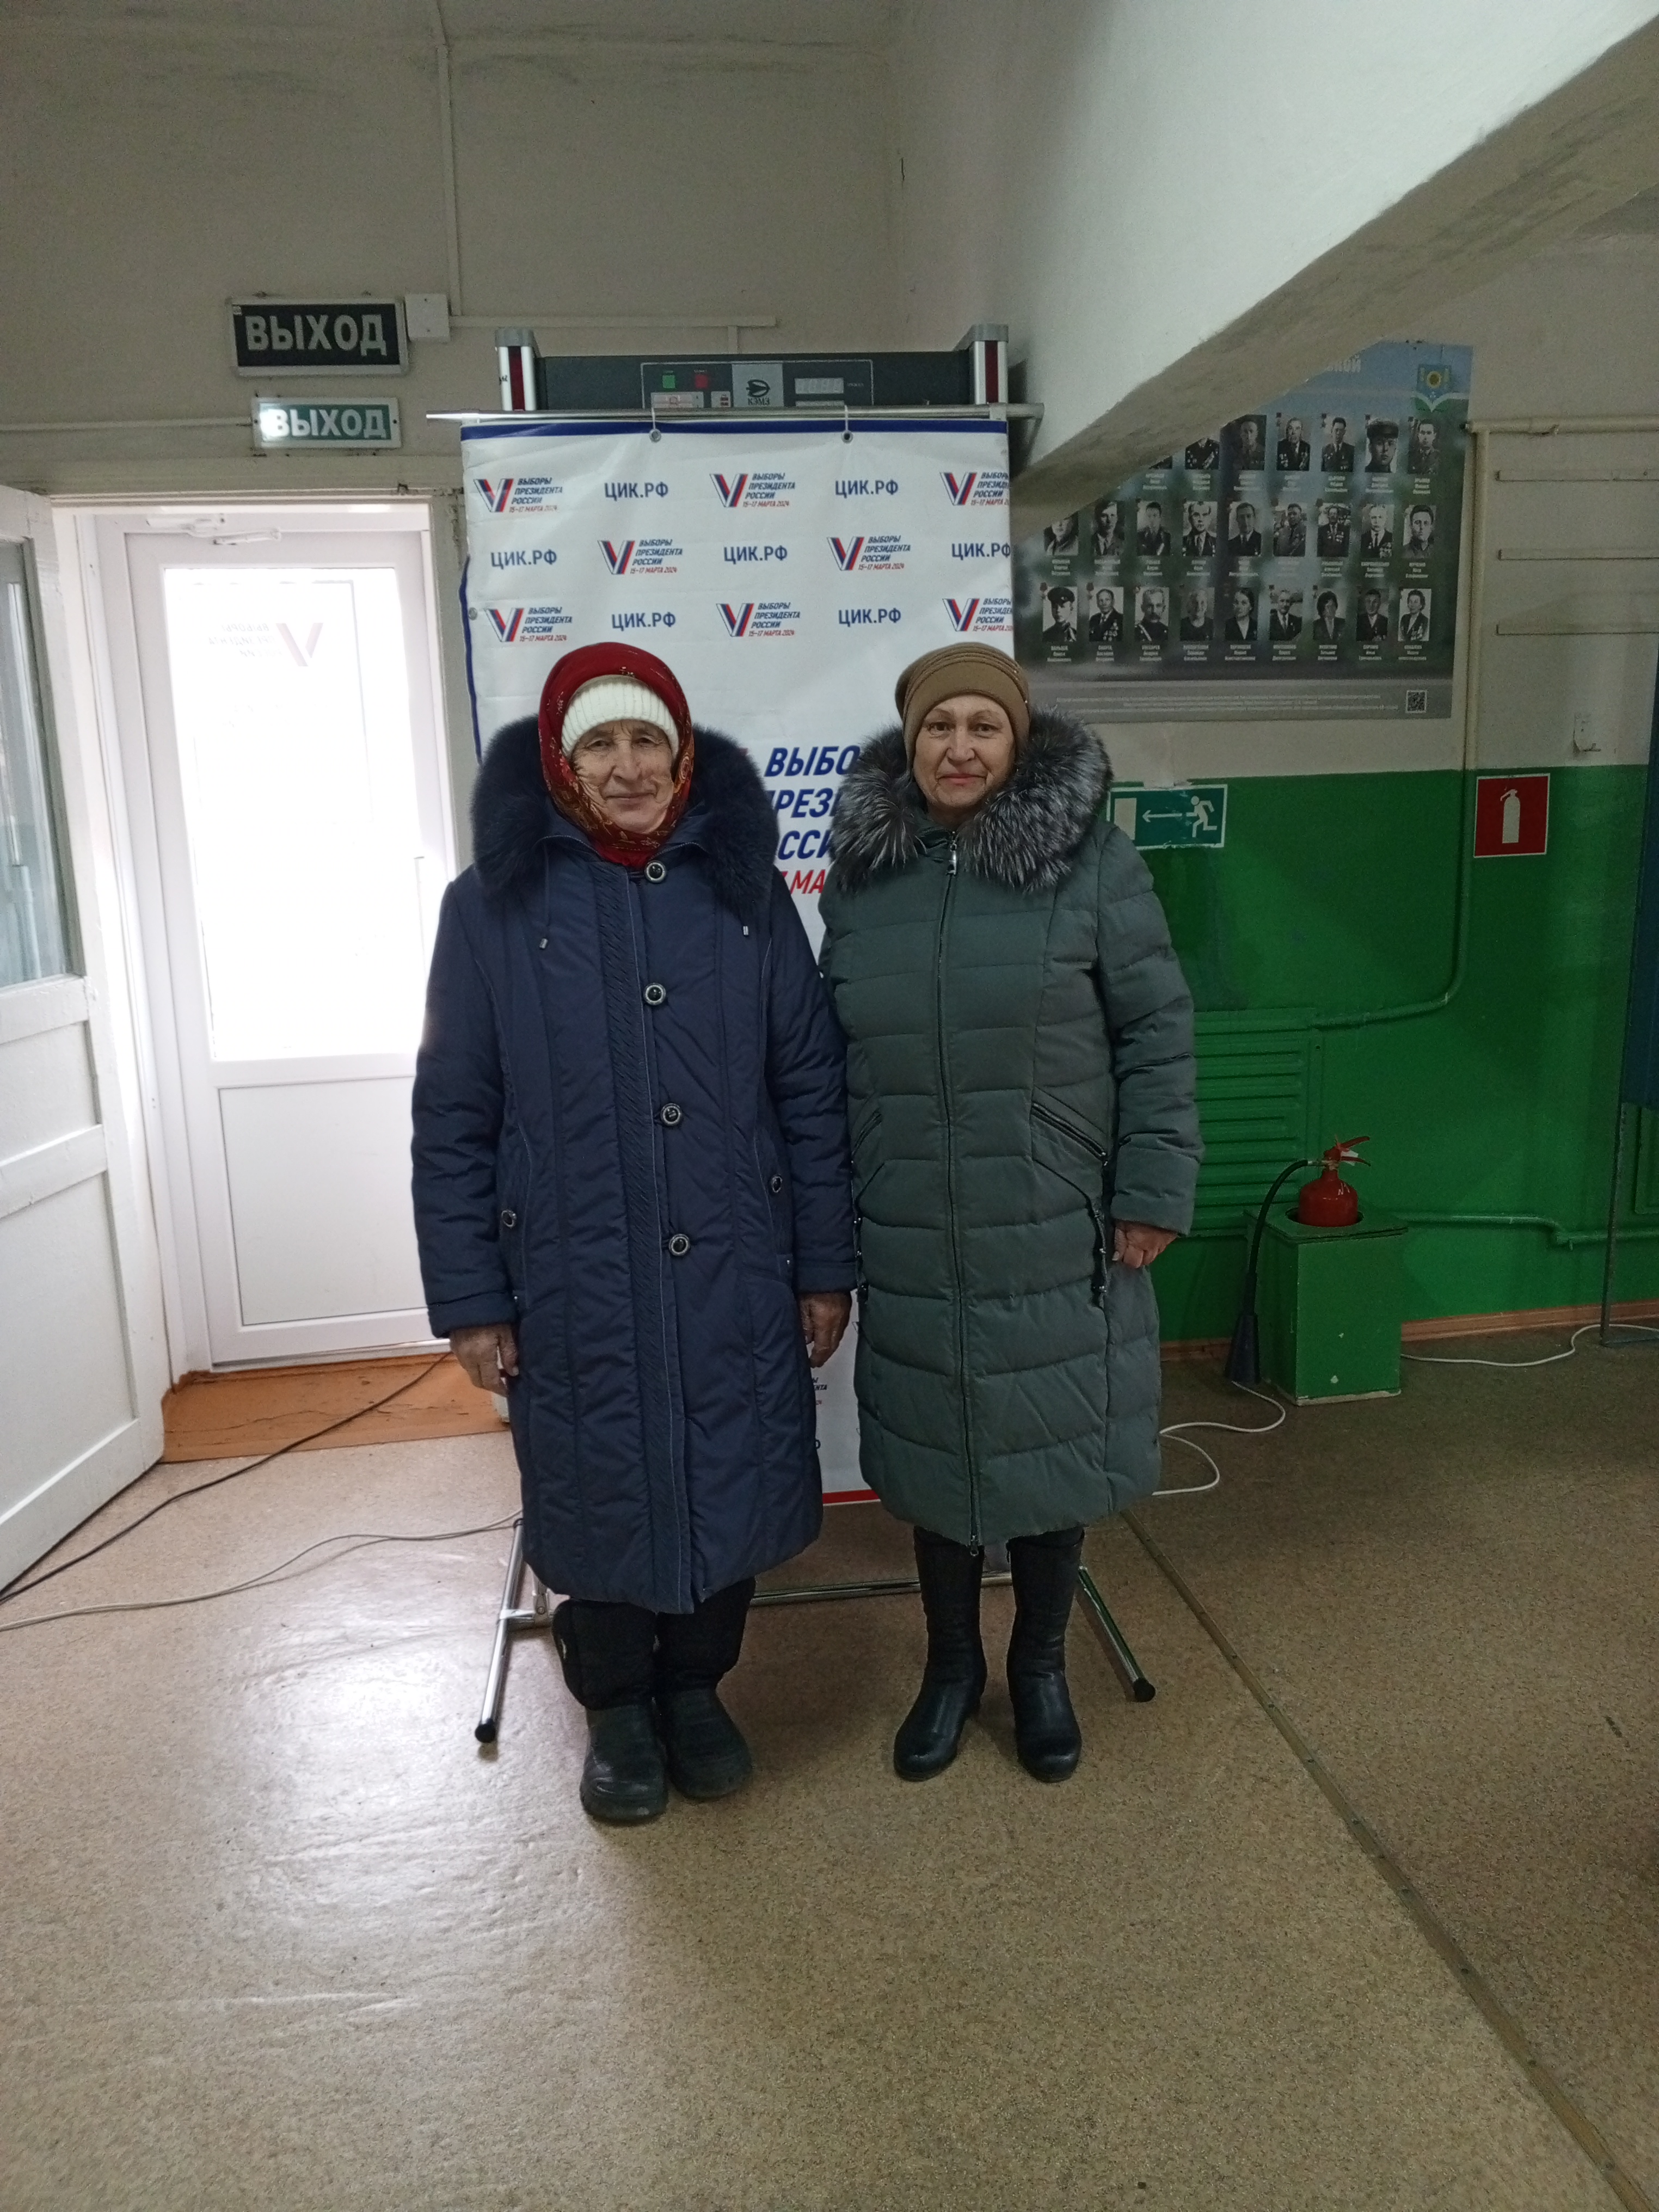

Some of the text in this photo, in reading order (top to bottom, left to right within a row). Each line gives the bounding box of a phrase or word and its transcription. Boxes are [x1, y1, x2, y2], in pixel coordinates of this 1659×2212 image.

[245, 314, 387, 357] ВЫХОД
[263, 408, 386, 439] ВЫХОД
[752, 472, 785, 481] ВЫБОРЫ
[604, 482, 668, 501] ЦИК.РФ
[748, 482, 796, 490] ПРЕЗИДЕНТА
[835, 480, 898, 499] ЦИК.РФ
[745, 491, 775, 499] РОССИИ
[635, 548, 683, 556] ПРЕЗИДЕНТА
[724, 545, 788, 564] ЦИК.РФ
[864, 544, 911, 552] ПРЕЗИДЕНТА
[951, 543, 1011, 560] ЦИК.РФ
[491, 549, 557, 569] ЦИК.РФ
[632, 557, 663, 566] РОССИИ
[528, 606, 562, 615] ВЫБОРЫ
[754, 611, 800, 619] ПРЕЗИДЕНТА
[838, 608, 901, 627] ЦИК.РФ
[521, 625, 553, 634] РОССИИ
[612, 612, 675, 631] ЦИК.РФ
[764, 745, 860, 777] ВЫБО
